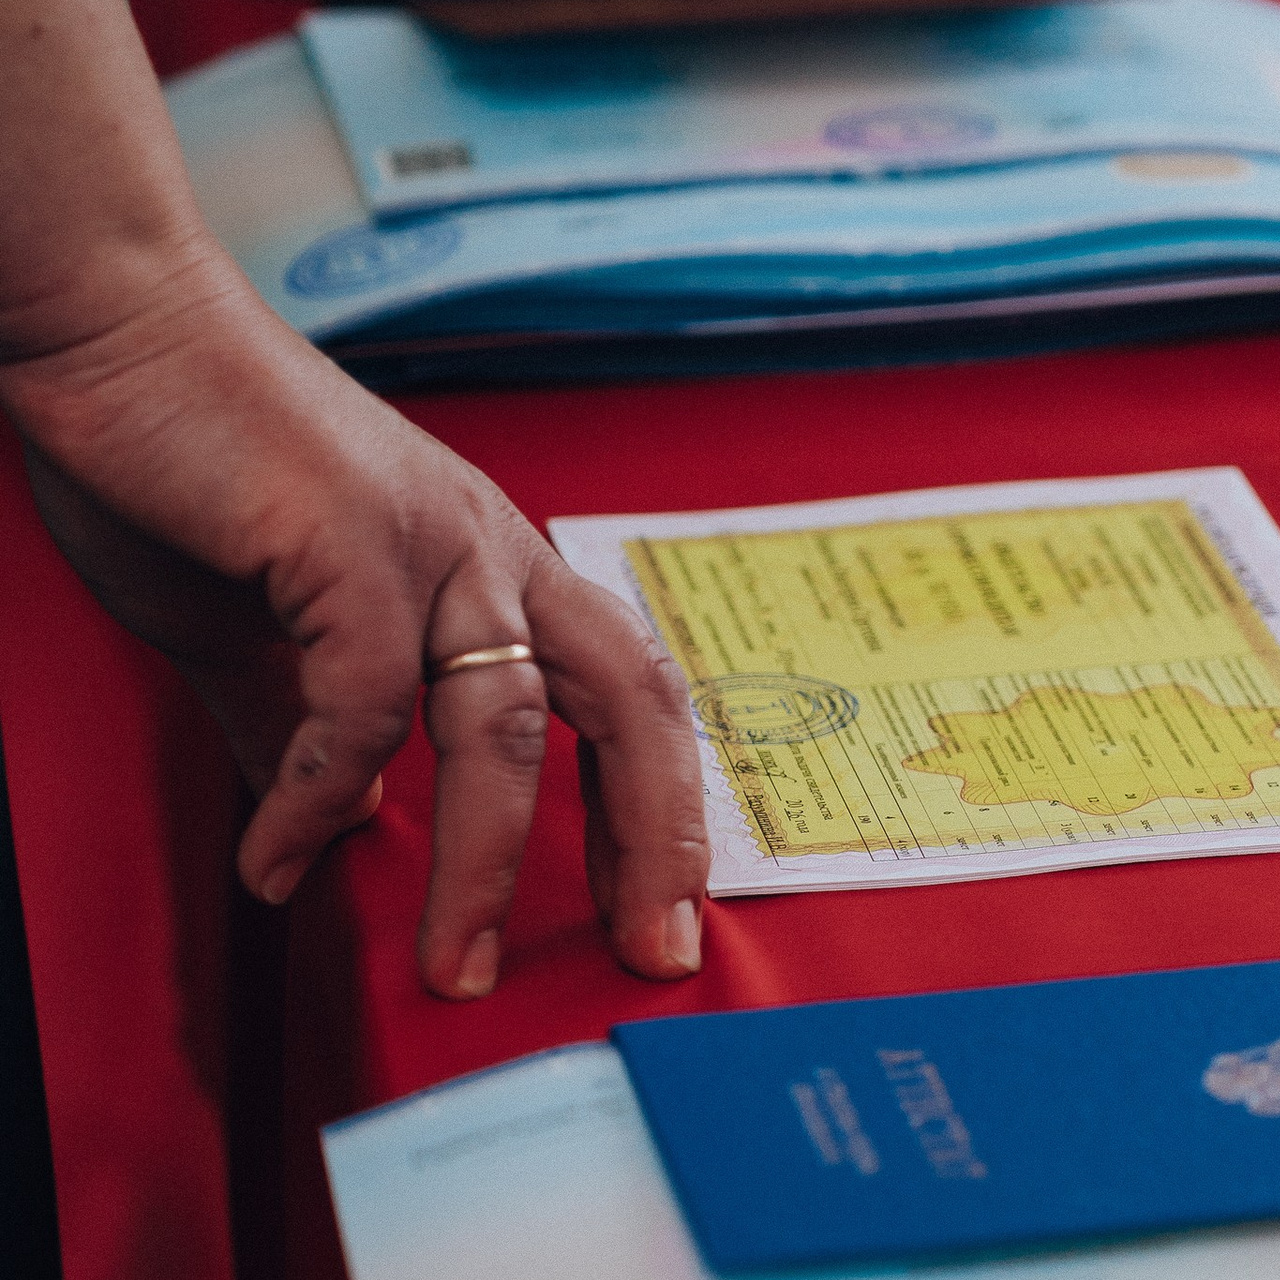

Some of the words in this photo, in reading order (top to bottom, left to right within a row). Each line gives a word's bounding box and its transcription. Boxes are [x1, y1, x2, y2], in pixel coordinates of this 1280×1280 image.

[791, 754, 815, 778] выдачи
[782, 798, 805, 809] 20
[802, 776, 835, 821] свидетельства
[790, 818, 811, 834] года
[856, 814, 873, 824] 190
